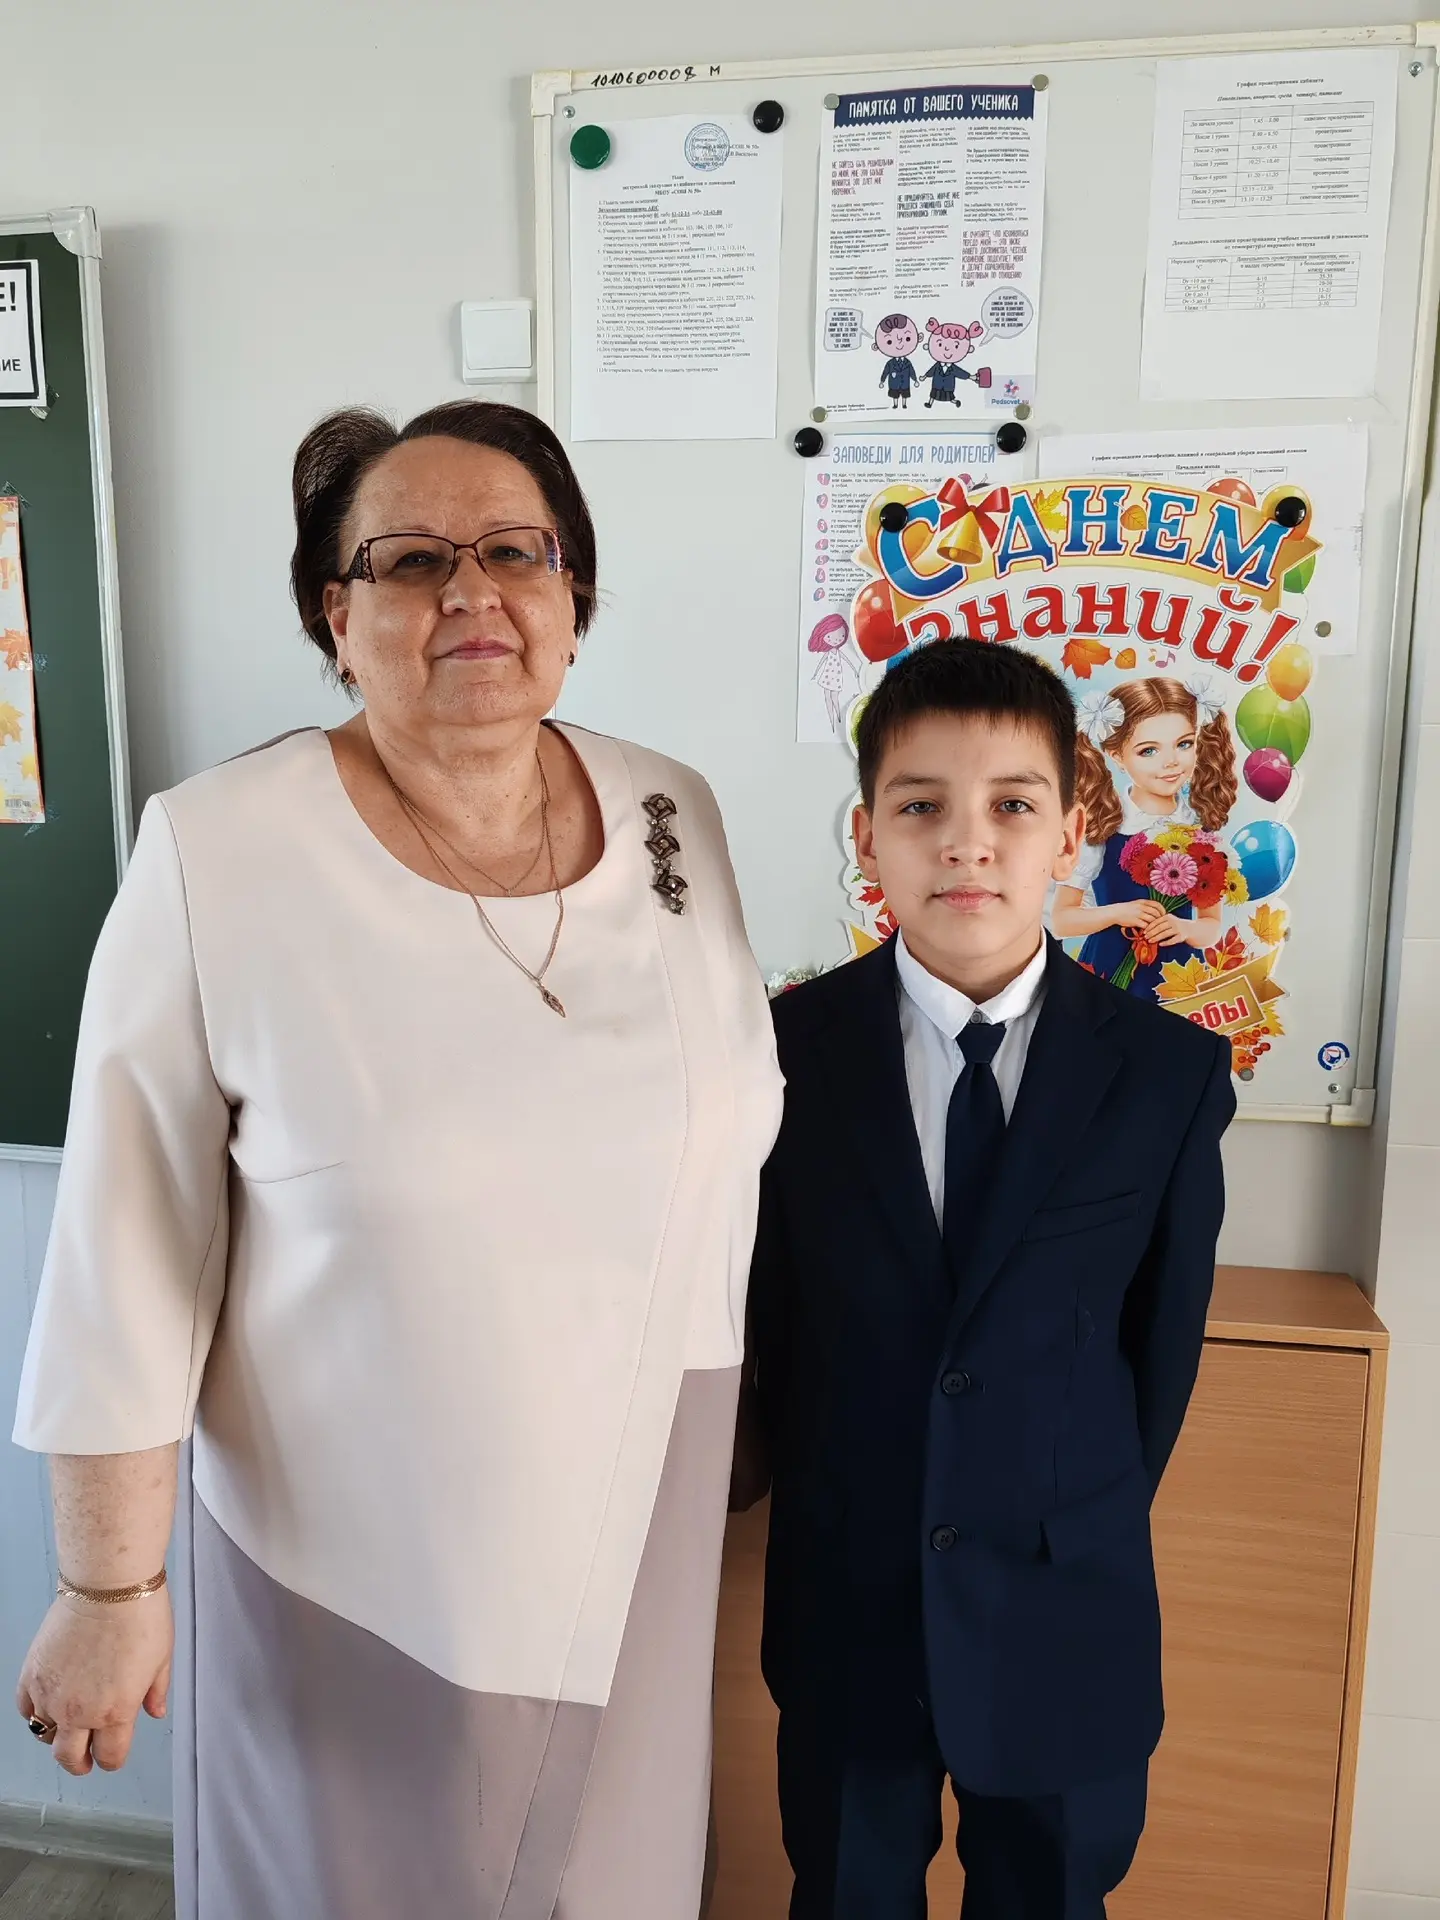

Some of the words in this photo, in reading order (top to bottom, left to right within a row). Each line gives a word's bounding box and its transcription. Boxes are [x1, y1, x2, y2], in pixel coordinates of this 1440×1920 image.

[848, 99, 897, 118] ПАМЯТКА
[903, 97, 917, 114] ОТ
[922, 94, 964, 112] ВАШЕГО
[971, 94, 1019, 112] УЧЕНИКА
[0, 359, 21, 372] ИЕ
[831, 446, 892, 464] ЗАПОВЕДИ
[898, 446, 924, 464] ДЛЯ
[930, 443, 996, 464] РОДИТЕЛЕЙ
[878, 493, 968, 600] С
[994, 486, 1293, 588] ДНЕМ
[906, 582, 1299, 683] знаний!
[1188, 997, 1248, 1029] ебы
